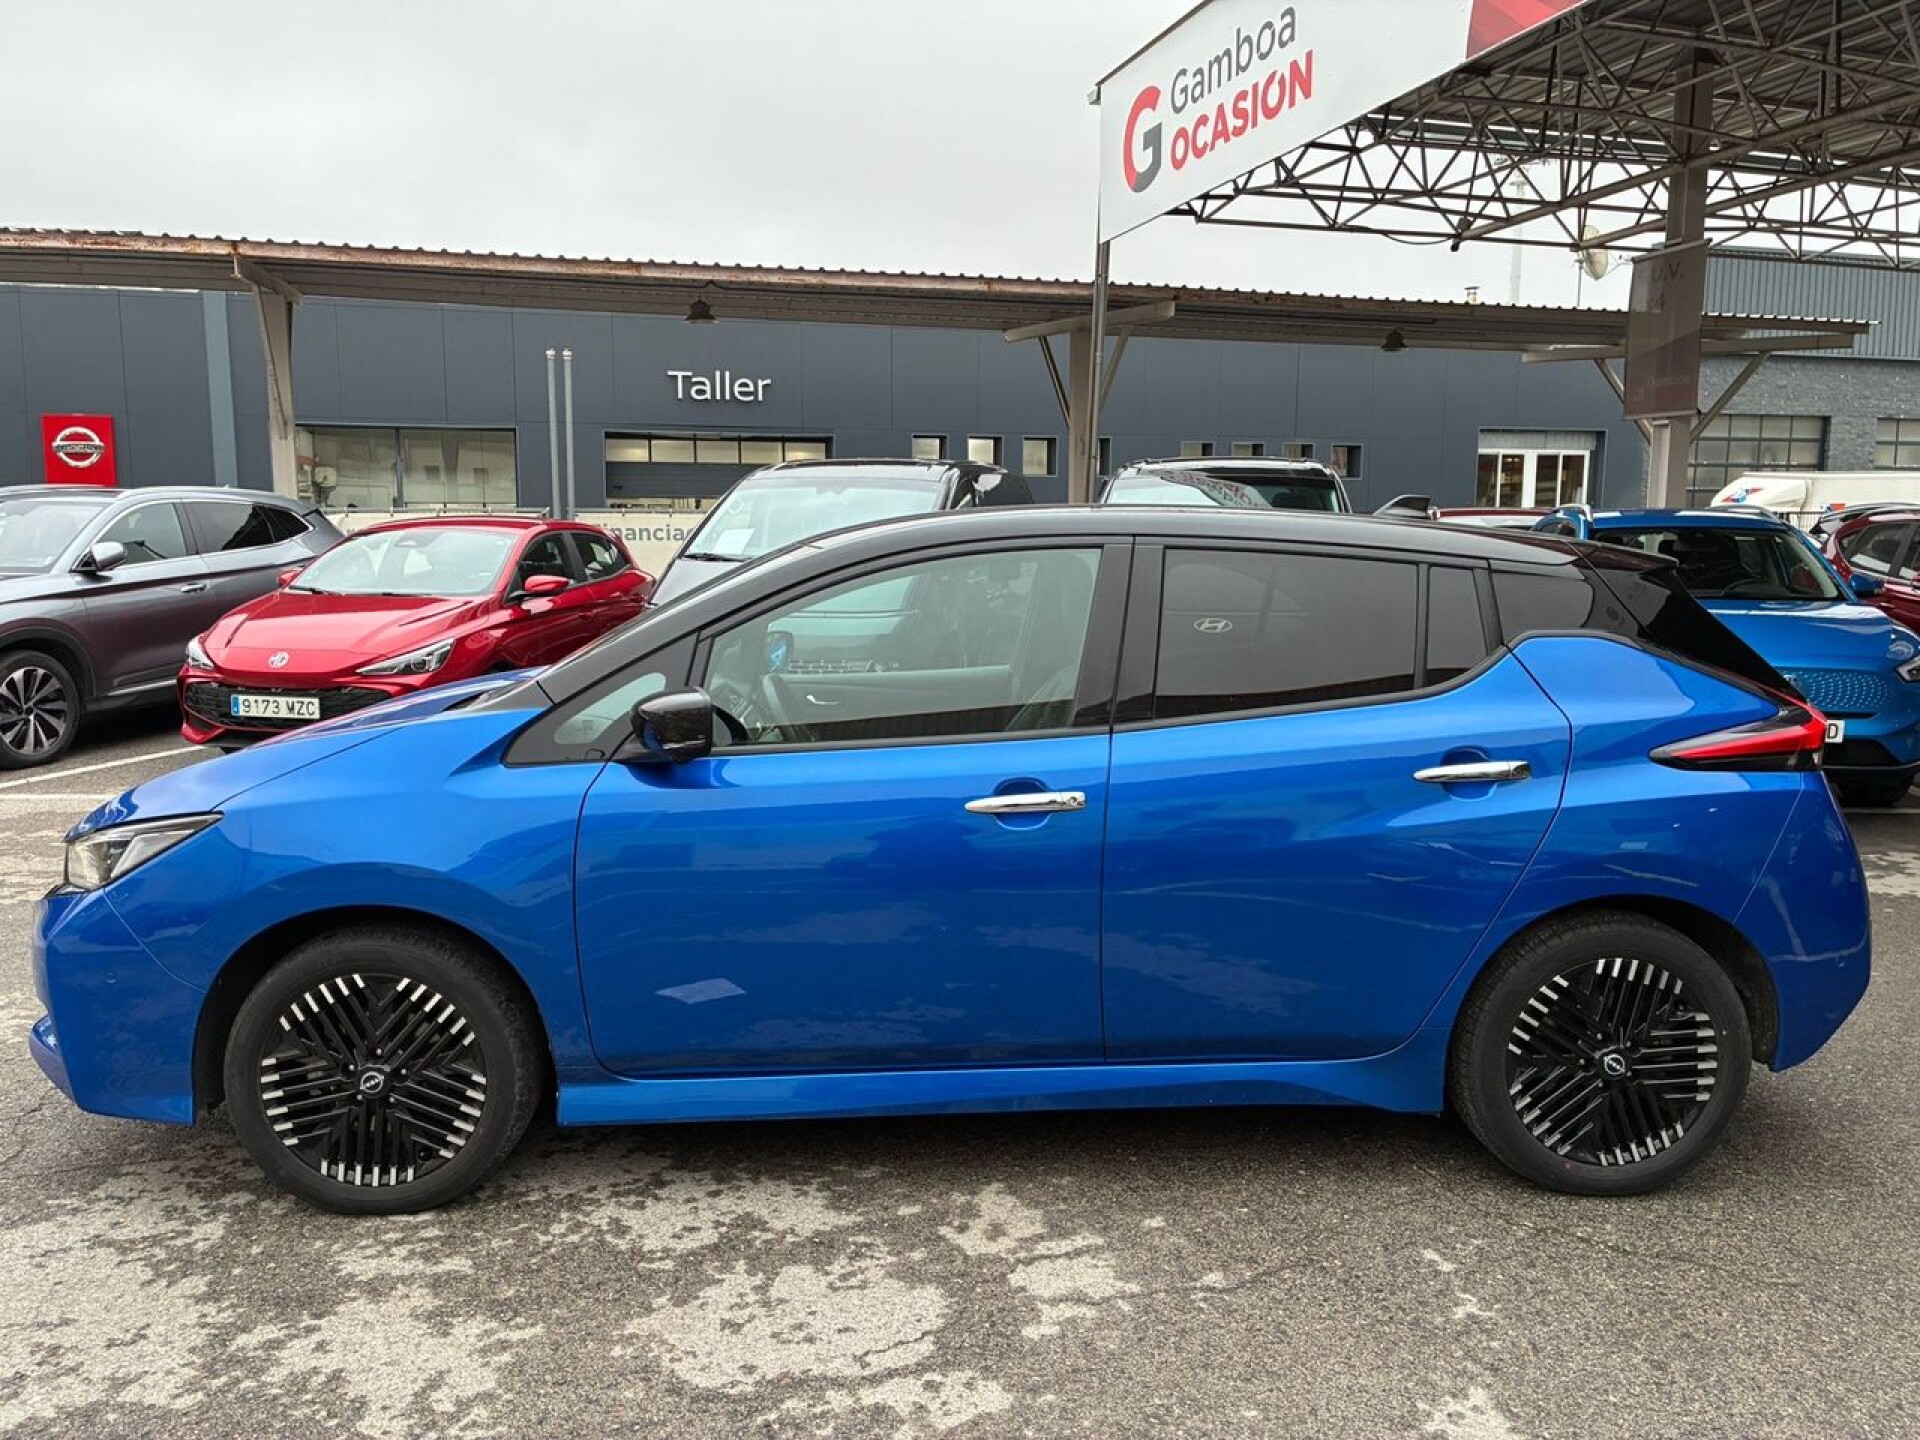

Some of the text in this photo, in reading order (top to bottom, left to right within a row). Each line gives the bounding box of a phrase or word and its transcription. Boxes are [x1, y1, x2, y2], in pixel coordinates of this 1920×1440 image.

[1170, 6, 1296, 115] Gamboa
[667, 370, 771, 401] Taller
[242, 698, 315, 716] 9173 MZC
[1827, 723, 1838, 739] D
